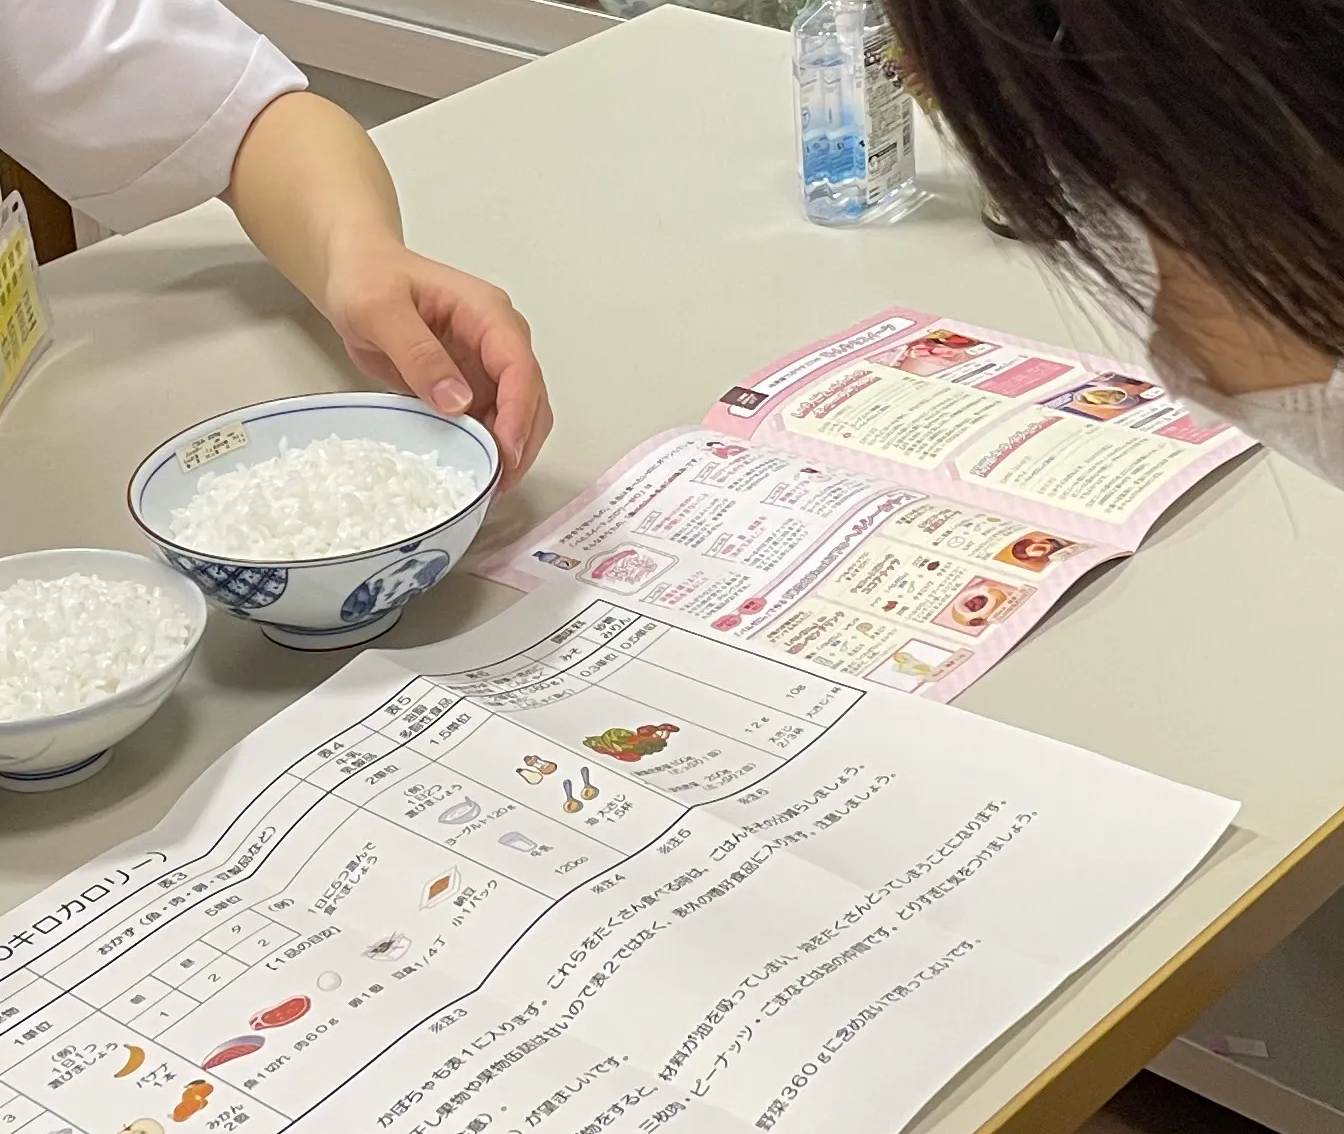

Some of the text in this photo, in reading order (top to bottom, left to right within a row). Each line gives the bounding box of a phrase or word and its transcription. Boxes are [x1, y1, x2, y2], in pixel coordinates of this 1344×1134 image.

[550, 620, 588, 644] 調味料
[593, 616, 617, 632] 砂糖
[600, 617, 632, 639] みりん
[559, 647, 582, 662] みそ
[383, 695, 413, 717] 表5
[428, 711, 473, 747] 1.5単位
[768, 725, 794, 745] 大さじ
[777, 727, 805, 749] 2/3杯
[316, 741, 345, 760] 表4
[336, 749, 362, 766] 牛乳
[339, 752, 378, 776] 乳製品
[365, 763, 401, 787] 2単位
[407, 783, 444, 806] 1日2つ
[596, 792, 627, 822] 大さじ
[605, 802, 635, 825] 1.5杯
[529, 842, 555, 859] 牛乳
[655, 828, 693, 856] ※注5
[157, 869, 189, 890] 表3
[323, 855, 380, 918] 食べましょう
[205, 893, 244, 919] 5単位
[451, 888, 476, 909] 納豆
[258, 937, 271, 950] 2
[208, 972, 223, 985] 2
[347, 982, 386, 1010] 卵1個
[159, 1010, 170, 1020] 1
[13, 1020, 54, 1047] 1単位
[47, 1041, 120, 1091] 選びましょう
[52, 1043, 98, 1075] 1日1つ
[136, 1062, 170, 1089] バナナ
[153, 1072, 178, 1089] 1本
[242, 1052, 292, 1092] 魚1切れ
[3, 1113, 17, 1124] 3
[204, 1102, 245, 1132] みかん
[223, 1112, 251, 1133] 2個
